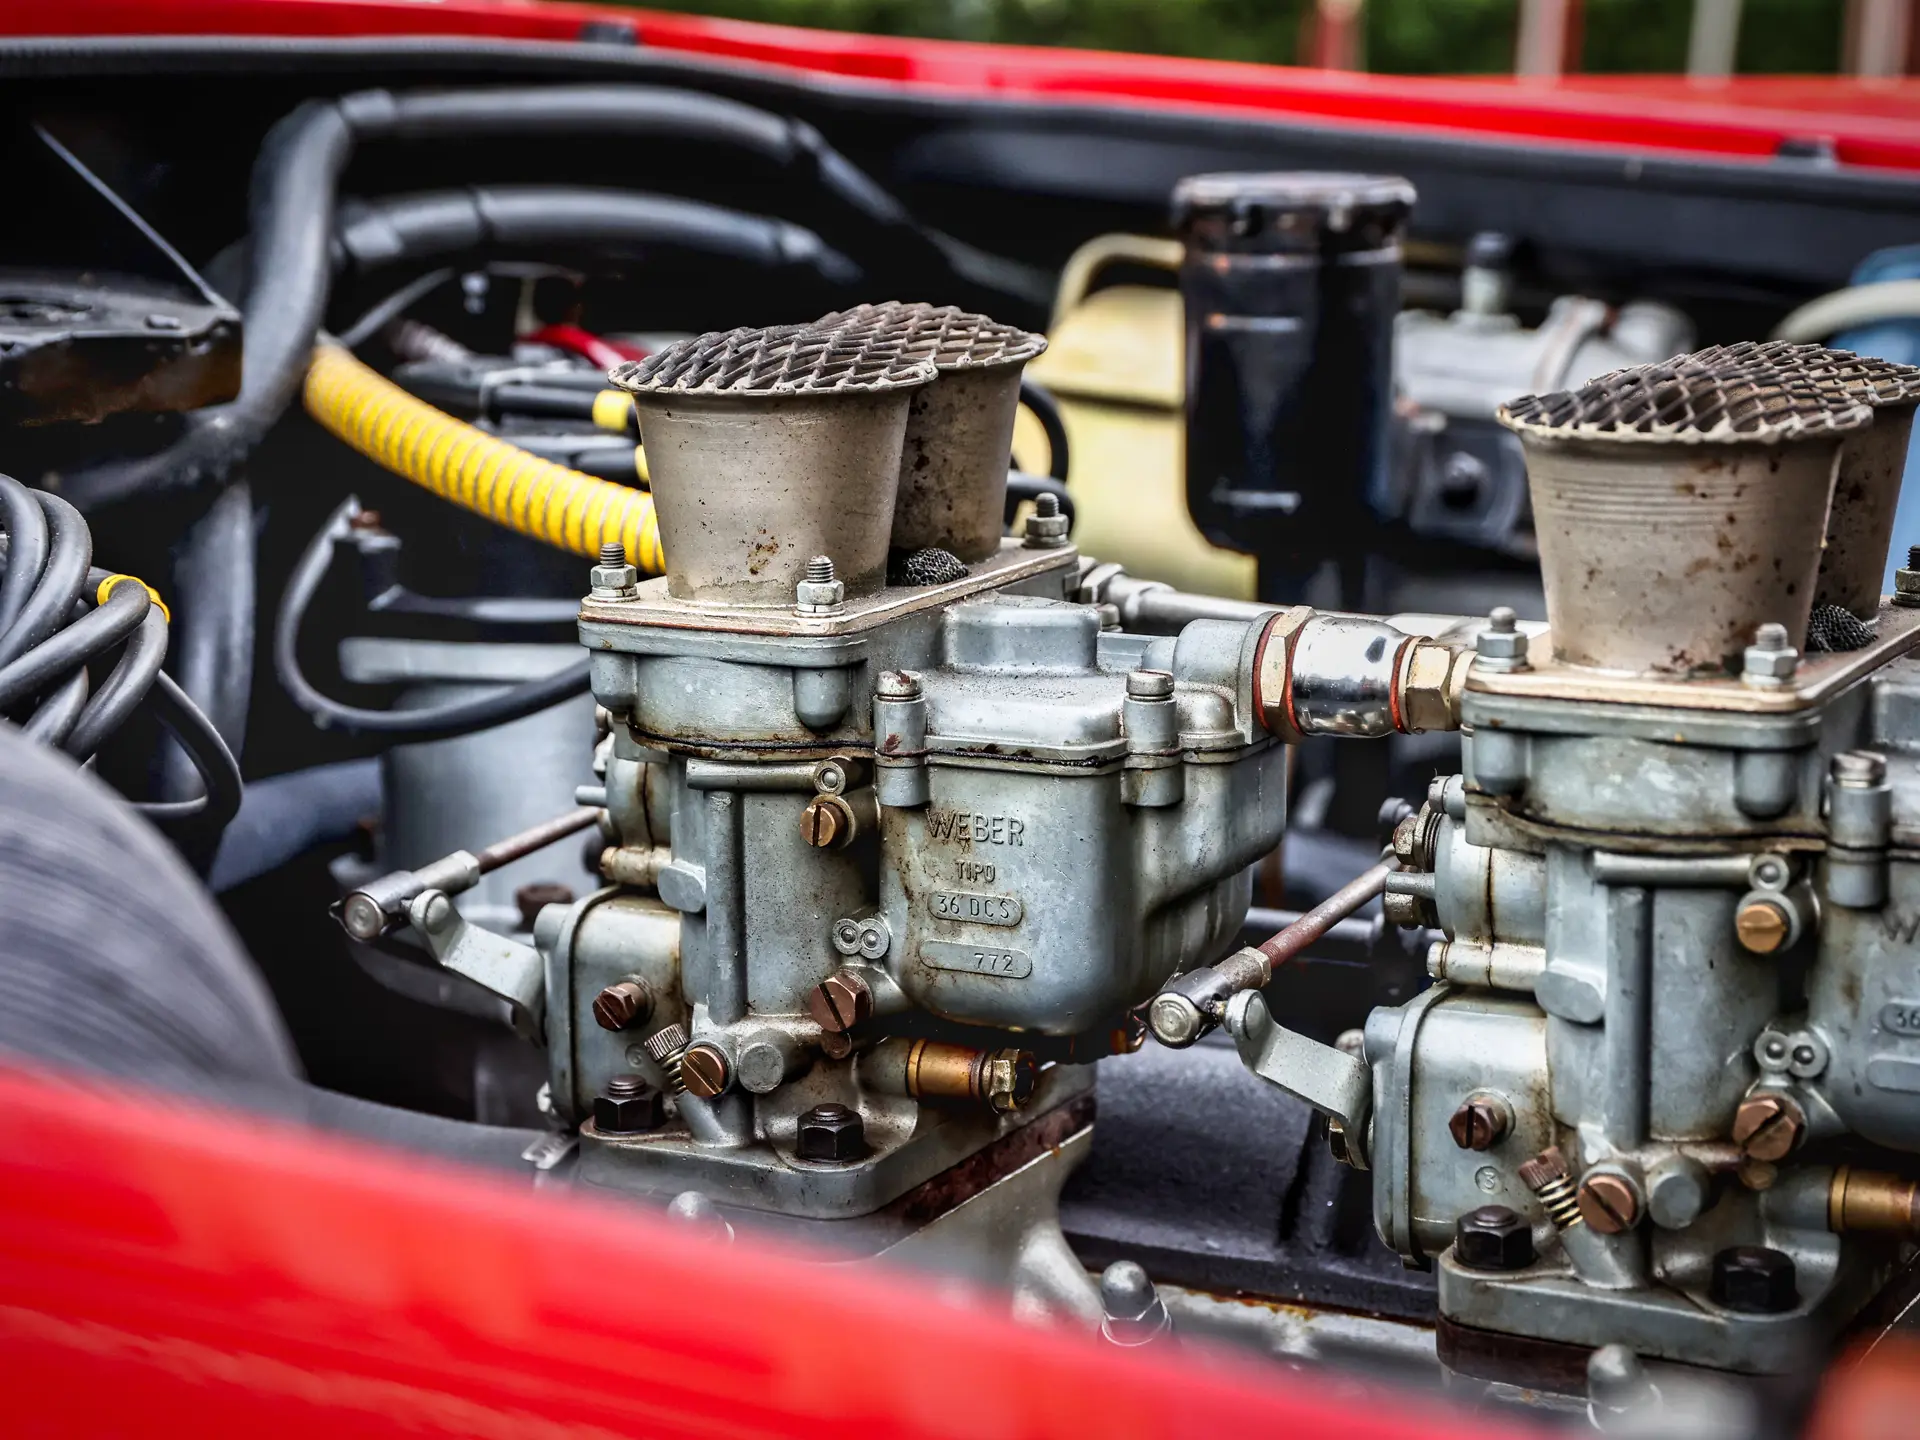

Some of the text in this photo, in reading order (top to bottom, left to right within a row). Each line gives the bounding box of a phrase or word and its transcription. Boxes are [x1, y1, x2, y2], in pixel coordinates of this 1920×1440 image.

[925, 808, 1024, 847] WEBER
[955, 859, 996, 884] TIPO
[937, 895, 960, 914] 36
[974, 953, 1013, 973] 772
